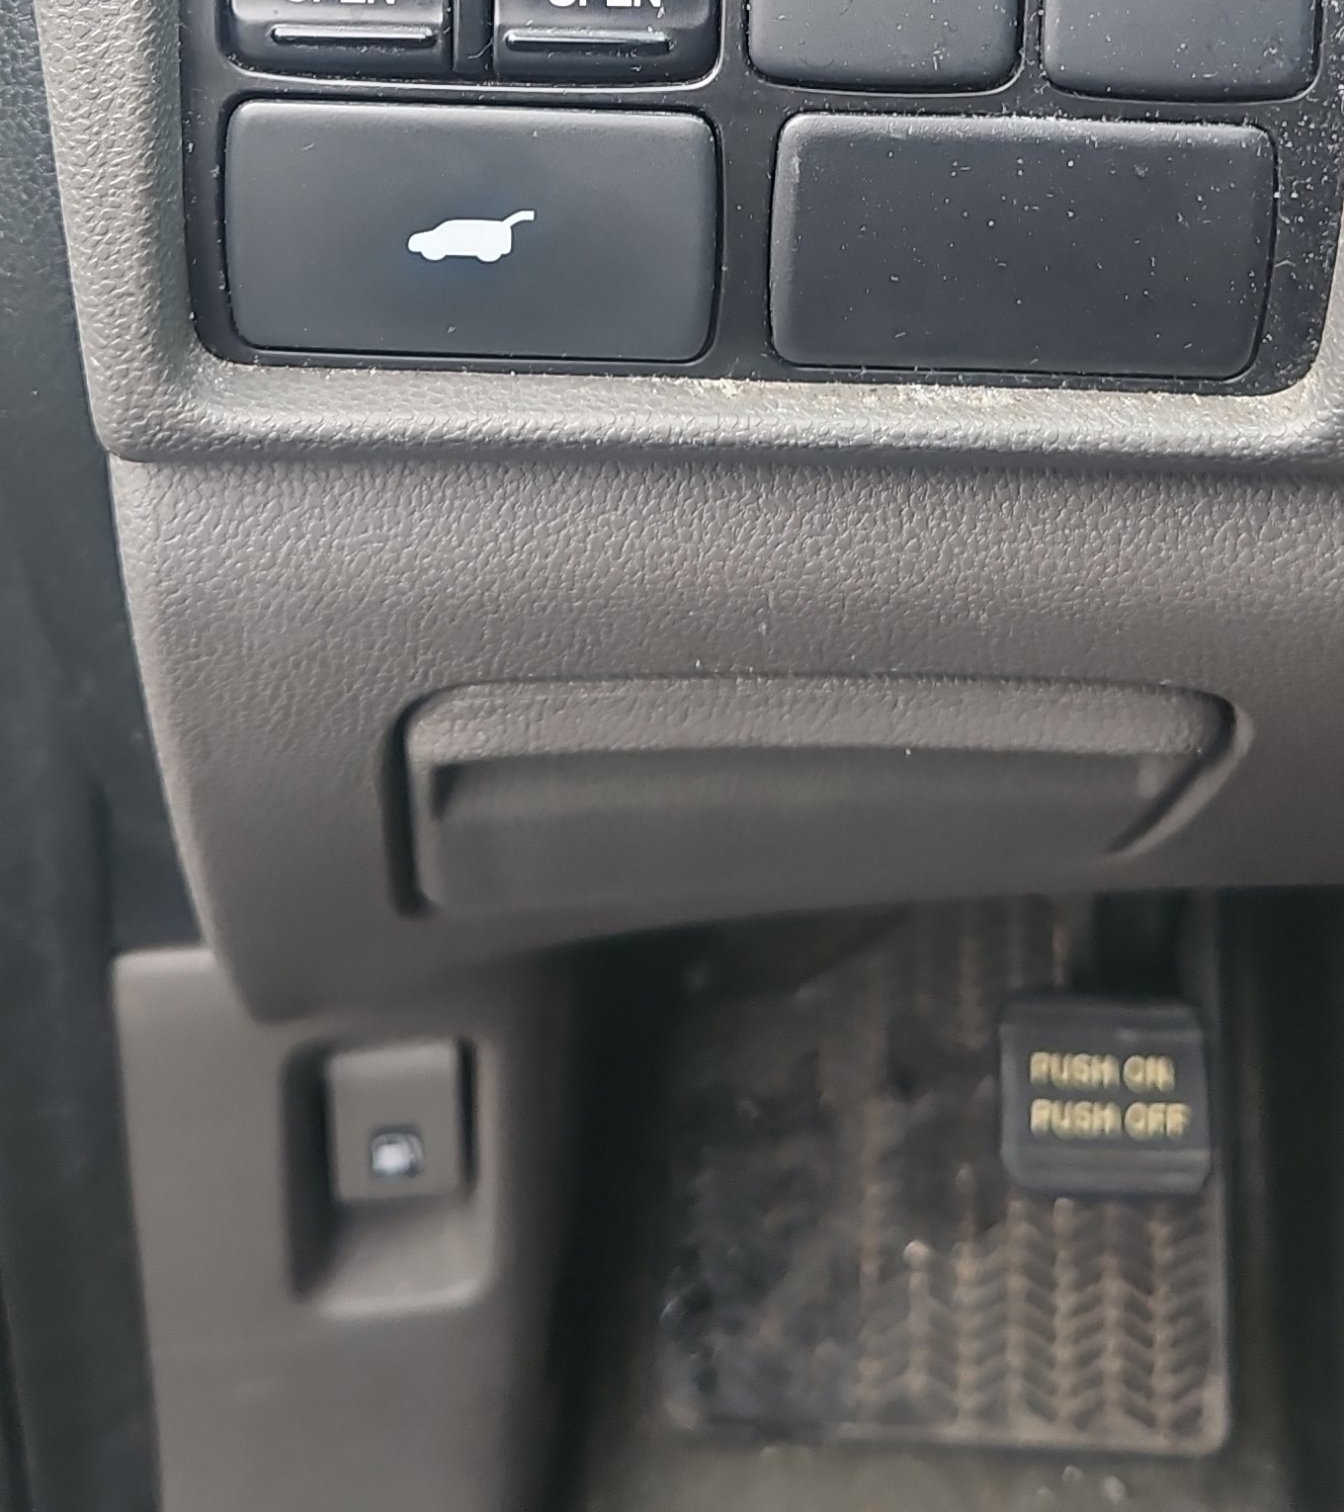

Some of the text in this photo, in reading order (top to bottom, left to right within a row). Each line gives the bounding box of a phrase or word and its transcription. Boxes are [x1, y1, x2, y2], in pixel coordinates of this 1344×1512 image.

[1030, 1051, 1176, 1093] PUSH ON
[1030, 1098, 1192, 1142] PUSH OFF
